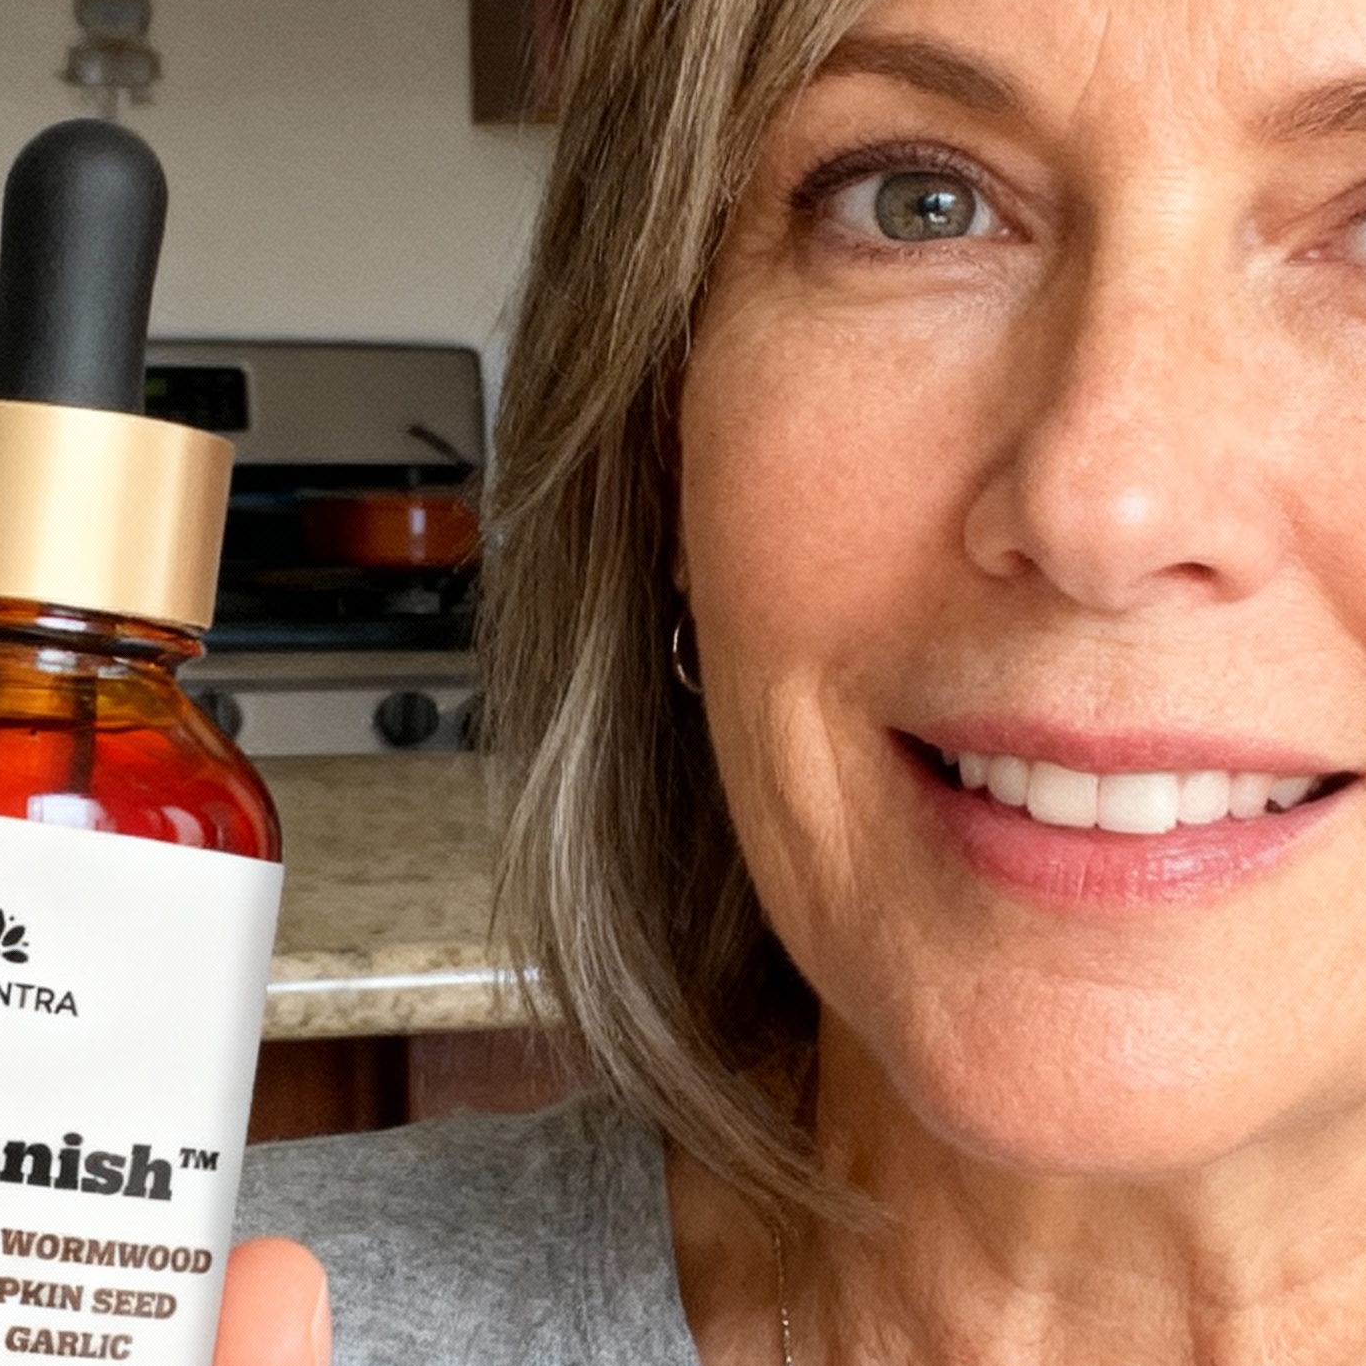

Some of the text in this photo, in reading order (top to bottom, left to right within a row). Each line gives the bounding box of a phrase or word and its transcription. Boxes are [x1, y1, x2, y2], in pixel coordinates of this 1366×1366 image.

[0, 1227, 214, 1275] WORMWOOD
[91, 1288, 178, 1320] SEED
[4, 1325, 133, 1361] GARLIC
